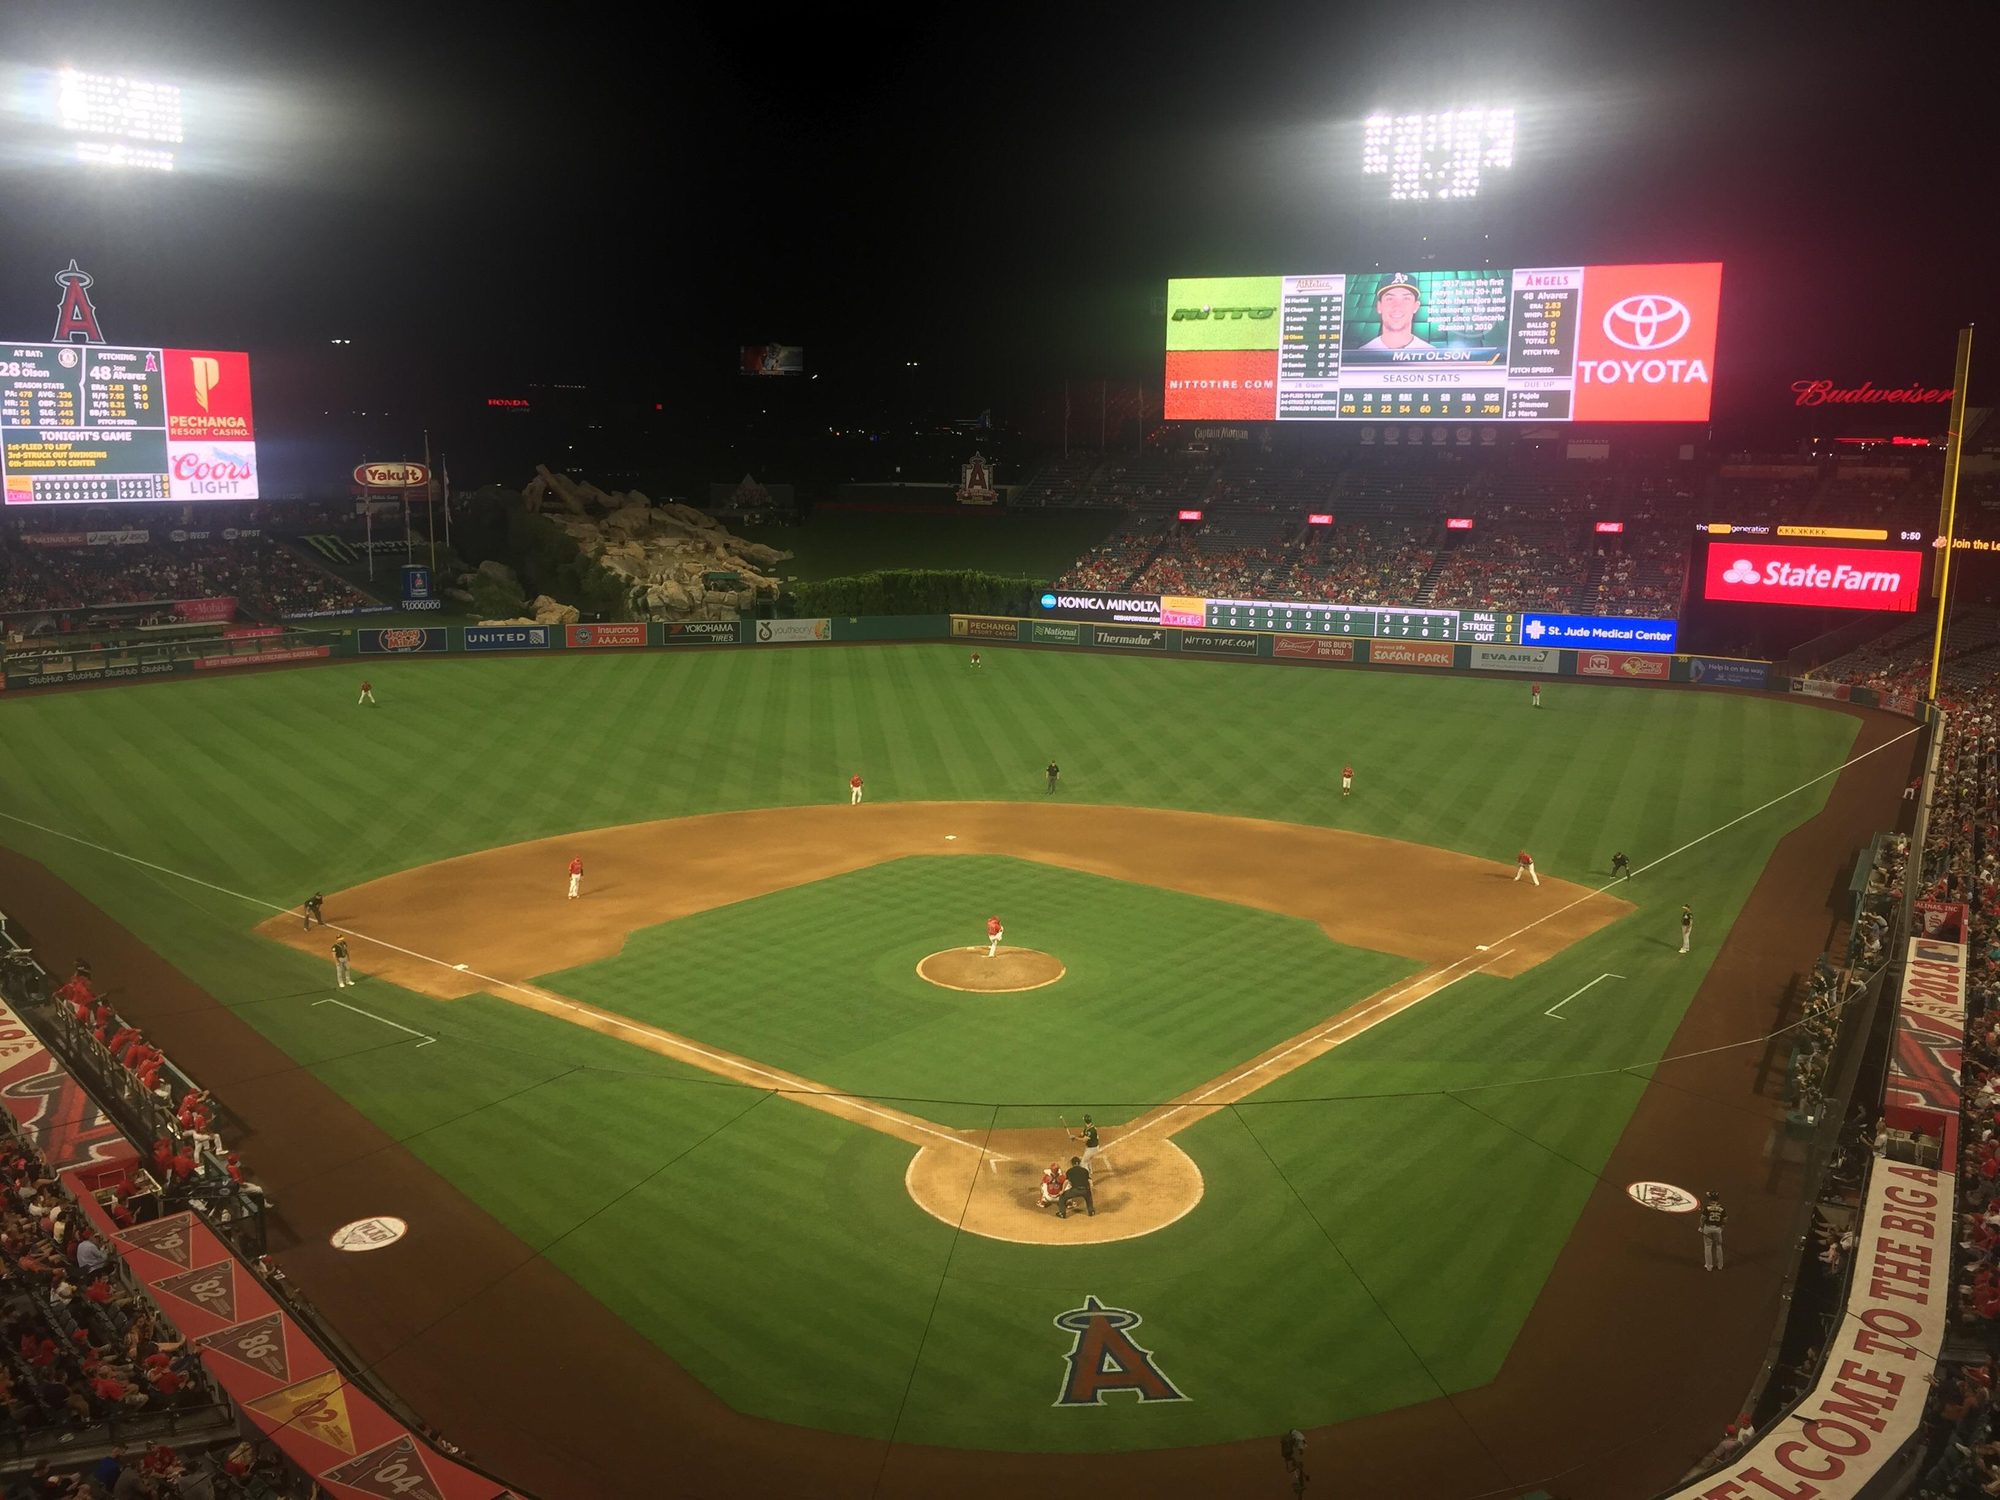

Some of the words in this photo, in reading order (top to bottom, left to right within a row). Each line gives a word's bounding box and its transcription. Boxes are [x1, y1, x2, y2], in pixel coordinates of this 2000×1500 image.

[1526, 275, 1569, 286] ANGELS
[1523, 292, 1534, 300] 48
[25, 350, 43, 358] BAT:
[98, 353, 137, 361] PITCHING:
[1392, 352, 1425, 361] MATT
[1426, 351, 1472, 360] OLSON
[0, 362, 20, 377] 28
[22, 369, 49, 377] Olson
[90, 366, 111, 380] 48
[1578, 360, 1708, 384] TOYOTA
[113, 371, 147, 380] Alvarez
[1383, 374, 1424, 382] SEASON
[1428, 374, 1460, 382] STATS
[1519, 392, 1540, 400] Pujols
[1791, 380, 1957, 407] Budweiser
[1341, 405, 1355, 413] 478
[1362, 405, 1372, 413] 21
[1381, 405, 1392, 413] 22
[1399, 405, 1410, 413] 54
[1420, 405, 1431, 413] 60
[1442, 405, 1448, 413] 2
[1465, 405, 1471, 413] 3
[1481, 405, 1500, 413] .769
[170, 415, 247, 429] PECHANGA
[40, 431, 100, 441] TONIGHT'S
[101, 431, 132, 441] GAME
[170, 428, 207, 436] RESORT
[212, 428, 247, 436] CASINO
[171, 453, 253, 481] Coors
[367, 469, 420, 481] Yakult
[190, 481, 239, 494] LIGHT
[1731, 525, 1769, 533] generation
[1901, 531, 1921, 540] 9:50
[1952, 538, 1971, 549] Join
[1973, 540, 1989, 550] the
[402, 600, 440, 610] $1,000,000
[1057, 596, 1105, 610] KONICA
[1106, 598, 1160, 613] MINOLTA
[1474, 613, 1495, 622] BALL
[597, 626, 639, 635] Insurance
[685, 623, 734, 633] YOKOHAMA
[970, 621, 1016, 632] PECHANGA
[1042, 626, 1077, 636] National
[1462, 623, 1495, 631] STRIKE
[468, 633, 526, 643] UNITED
[1096, 632, 1152, 645] Thermador
[1475, 633, 1493, 641] OUT
[1548, 626, 1561, 635] St.
[1564, 627, 1590, 637] Jude
[1593, 628, 1633, 639] Medical
[1636, 631, 1672, 641] Center
[597, 636, 640, 645] AAA.com
[1184, 636, 1211, 645] NITTO
[1214, 637, 1255, 648] TIRE.COM
[1317, 640, 1333, 648] THIS
[1334, 641, 1353, 649] BUD'S
[1374, 650, 1416, 662] SAFARI
[1417, 653, 1448, 663] PARK
[1481, 653, 1508, 662] EVA
[1509, 654, 1531, 662] AIR
[105, 669, 138, 678] StubHub
[141, 665, 173, 674] StubHub
[29, 676, 63, 685] StubHub
[67, 672, 101, 681] StubHub
[1914, 902, 1943, 911] ALINAS,
[1907, 960, 1960, 1005] 2018
[1887, 1165, 1938, 1188] A
[1709, 1212, 1720, 1221] 25
[1880, 1186, 1938, 1241] BIG
[1869, 1236, 1933, 1306] THE
[190, 1276, 227, 1303] '82
[1853, 1308, 1922, 1361] TO
[238, 1330, 278, 1359] '86
[375, 1458, 423, 1495] '04
